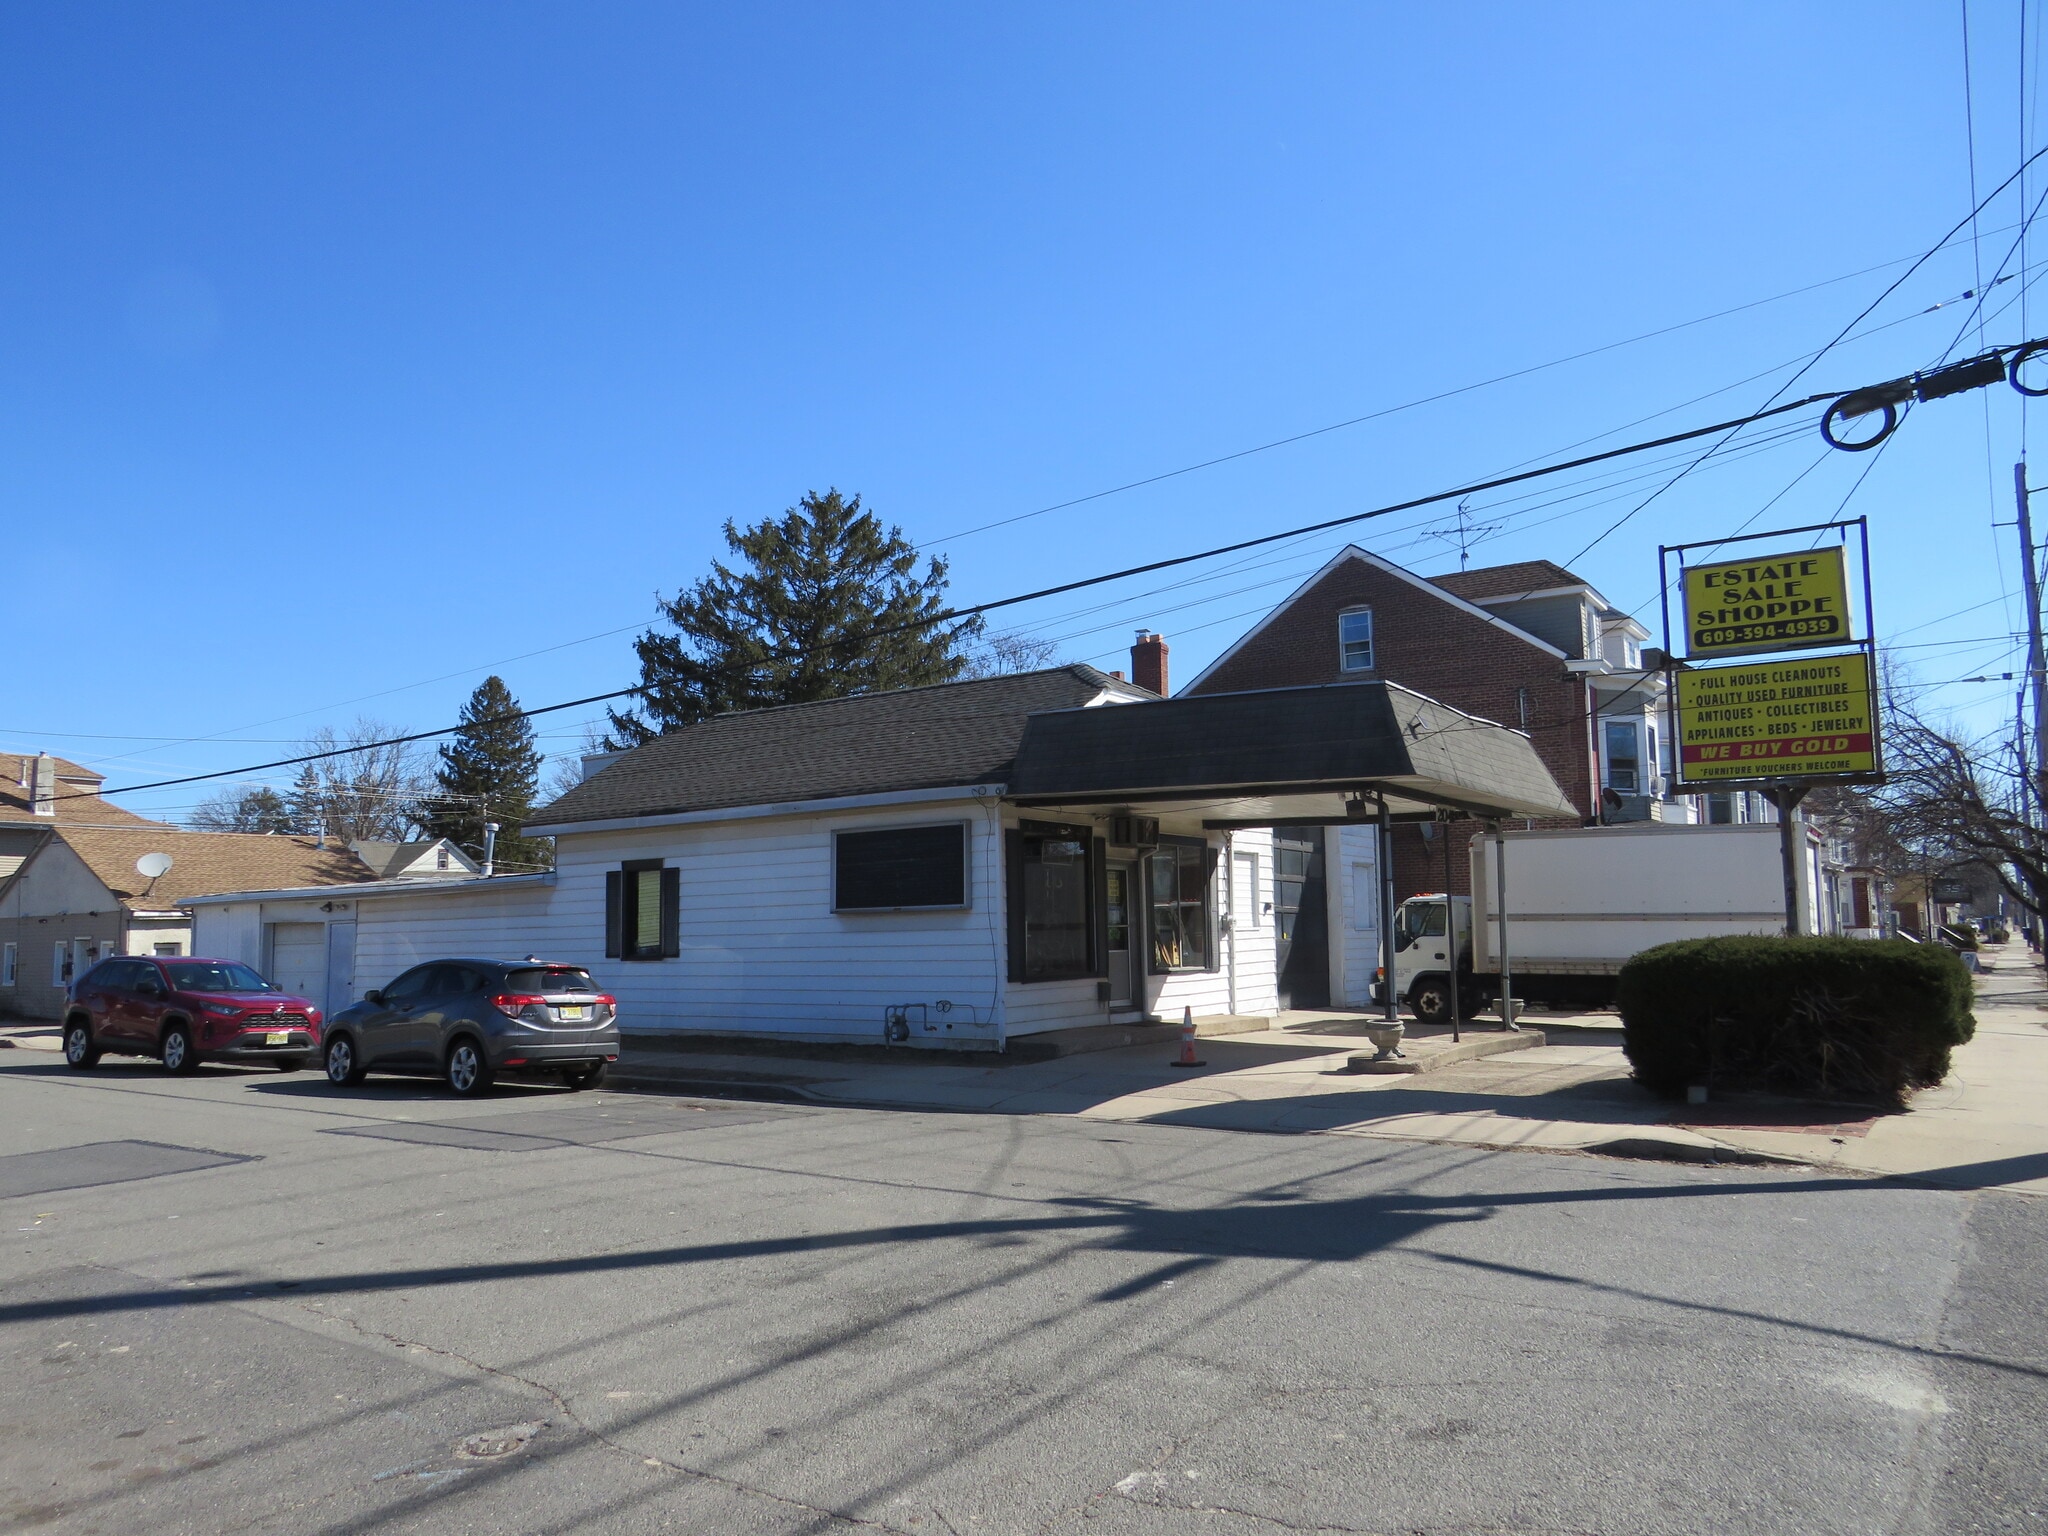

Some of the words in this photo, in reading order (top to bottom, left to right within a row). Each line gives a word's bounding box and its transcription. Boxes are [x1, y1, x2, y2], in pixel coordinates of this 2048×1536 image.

[1704, 560, 1818, 588] ESTATE
[1723, 581, 1802, 604] SALE
[1697, 597, 1832, 626] SHOPPE
[1702, 619, 1831, 644] 609-394-4939
[1700, 677, 1725, 689] FULL
[1730, 673, 1767, 686] HOUSE
[1772, 666, 1841, 682] CLEANOUTS
[1696, 692, 1742, 706] QUALITY
[1747, 689, 1776, 702] USED
[1781, 683, 1848, 699] FURNITURE
[1697, 708, 1753, 722] ANTIQUES
[1766, 700, 1849, 717] COLLECTIBLES
[1687, 725, 1754, 740] APPLIANCES
[1768, 722, 1797, 735] BEDS
[1811, 717, 1863, 732] JEWELRY
[1700, 746, 1731, 759] WE
[1740, 742, 1782, 757] BUY
[1790, 738, 1849, 753] GOLD
[1755, 763, 1803, 773] VOUCHERS
[1806, 760, 1851, 770] WELCOME
